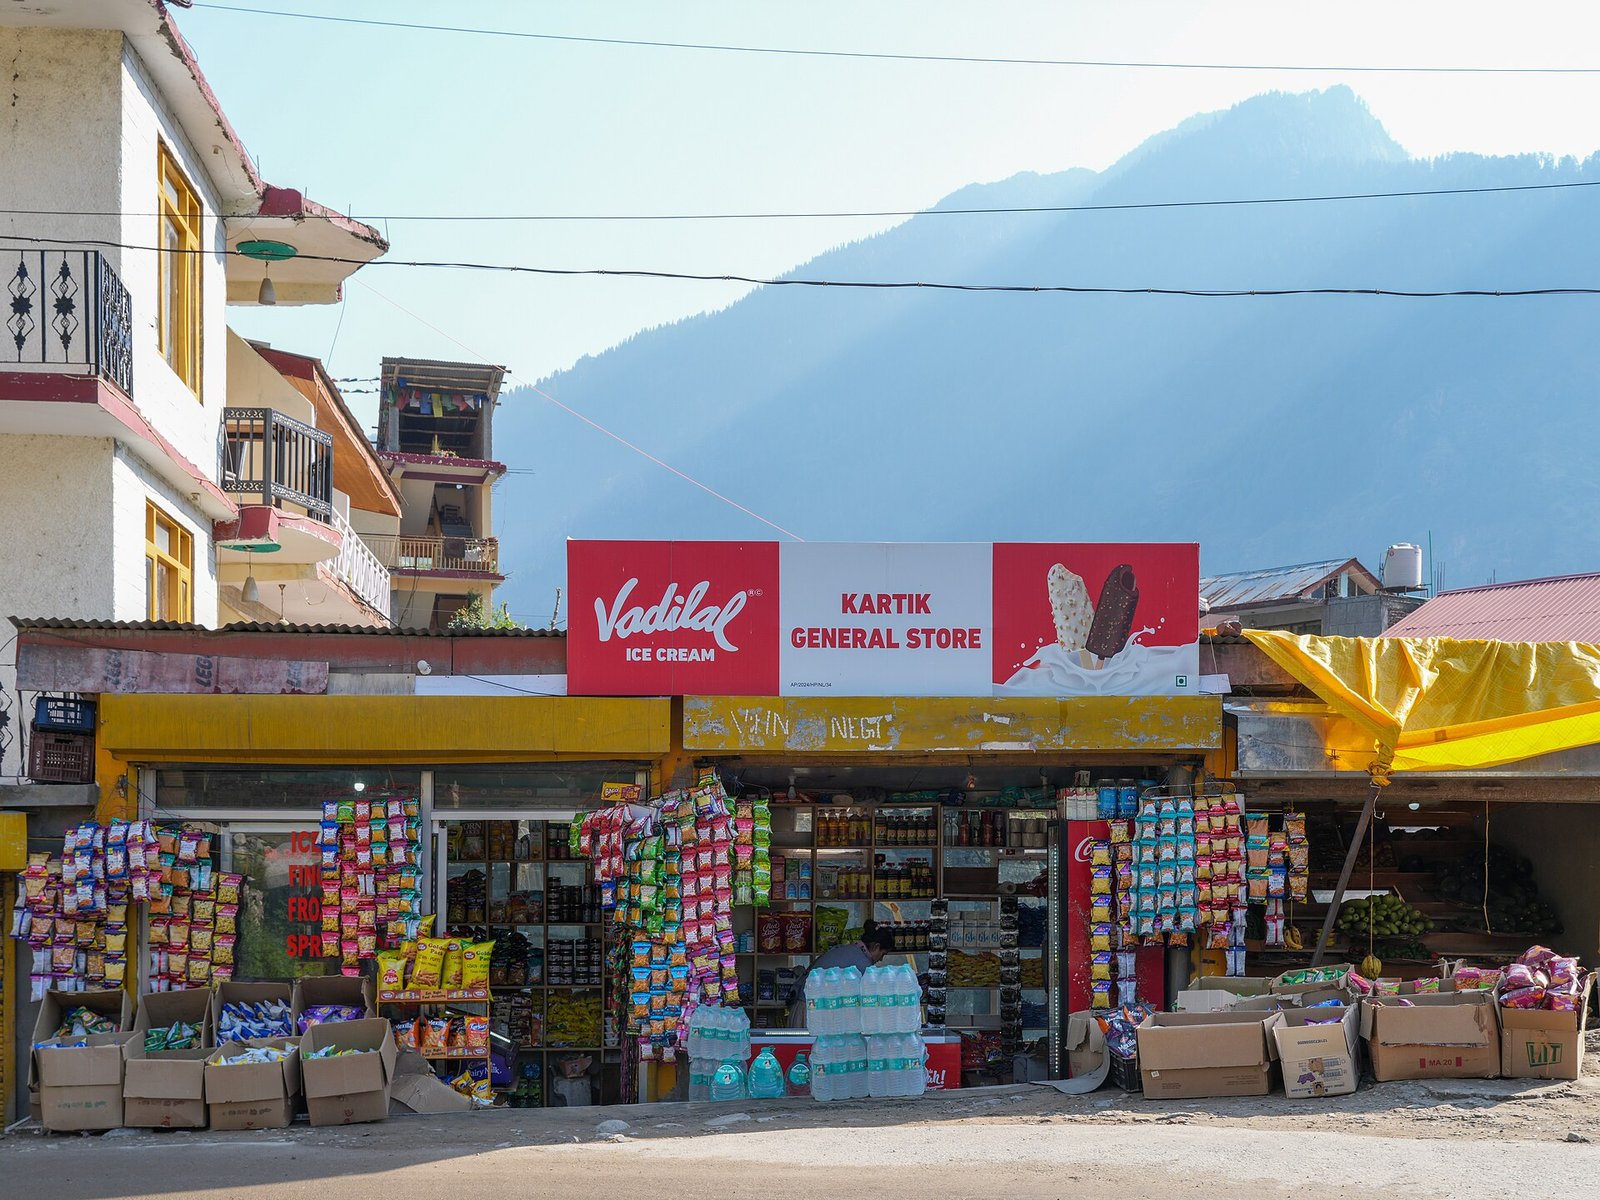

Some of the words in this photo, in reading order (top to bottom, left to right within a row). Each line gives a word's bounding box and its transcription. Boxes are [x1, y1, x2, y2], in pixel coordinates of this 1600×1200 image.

[594, 577, 747, 652] Vadilal
[841, 593, 931, 614] KARTIK
[791, 627, 900, 649] GENERAL
[906, 627, 982, 649] STORE
[626, 647, 652, 661] ICE
[656, 647, 715, 662] CREAM
[194, 655, 213, 688] LEG
[288, 864, 323, 887] FIN
[287, 897, 324, 922] FRO
[468, 1068, 484, 1078] airy
[1428, 1059, 1442, 1067] MA
[1443, 1058, 1453, 1066] 20
